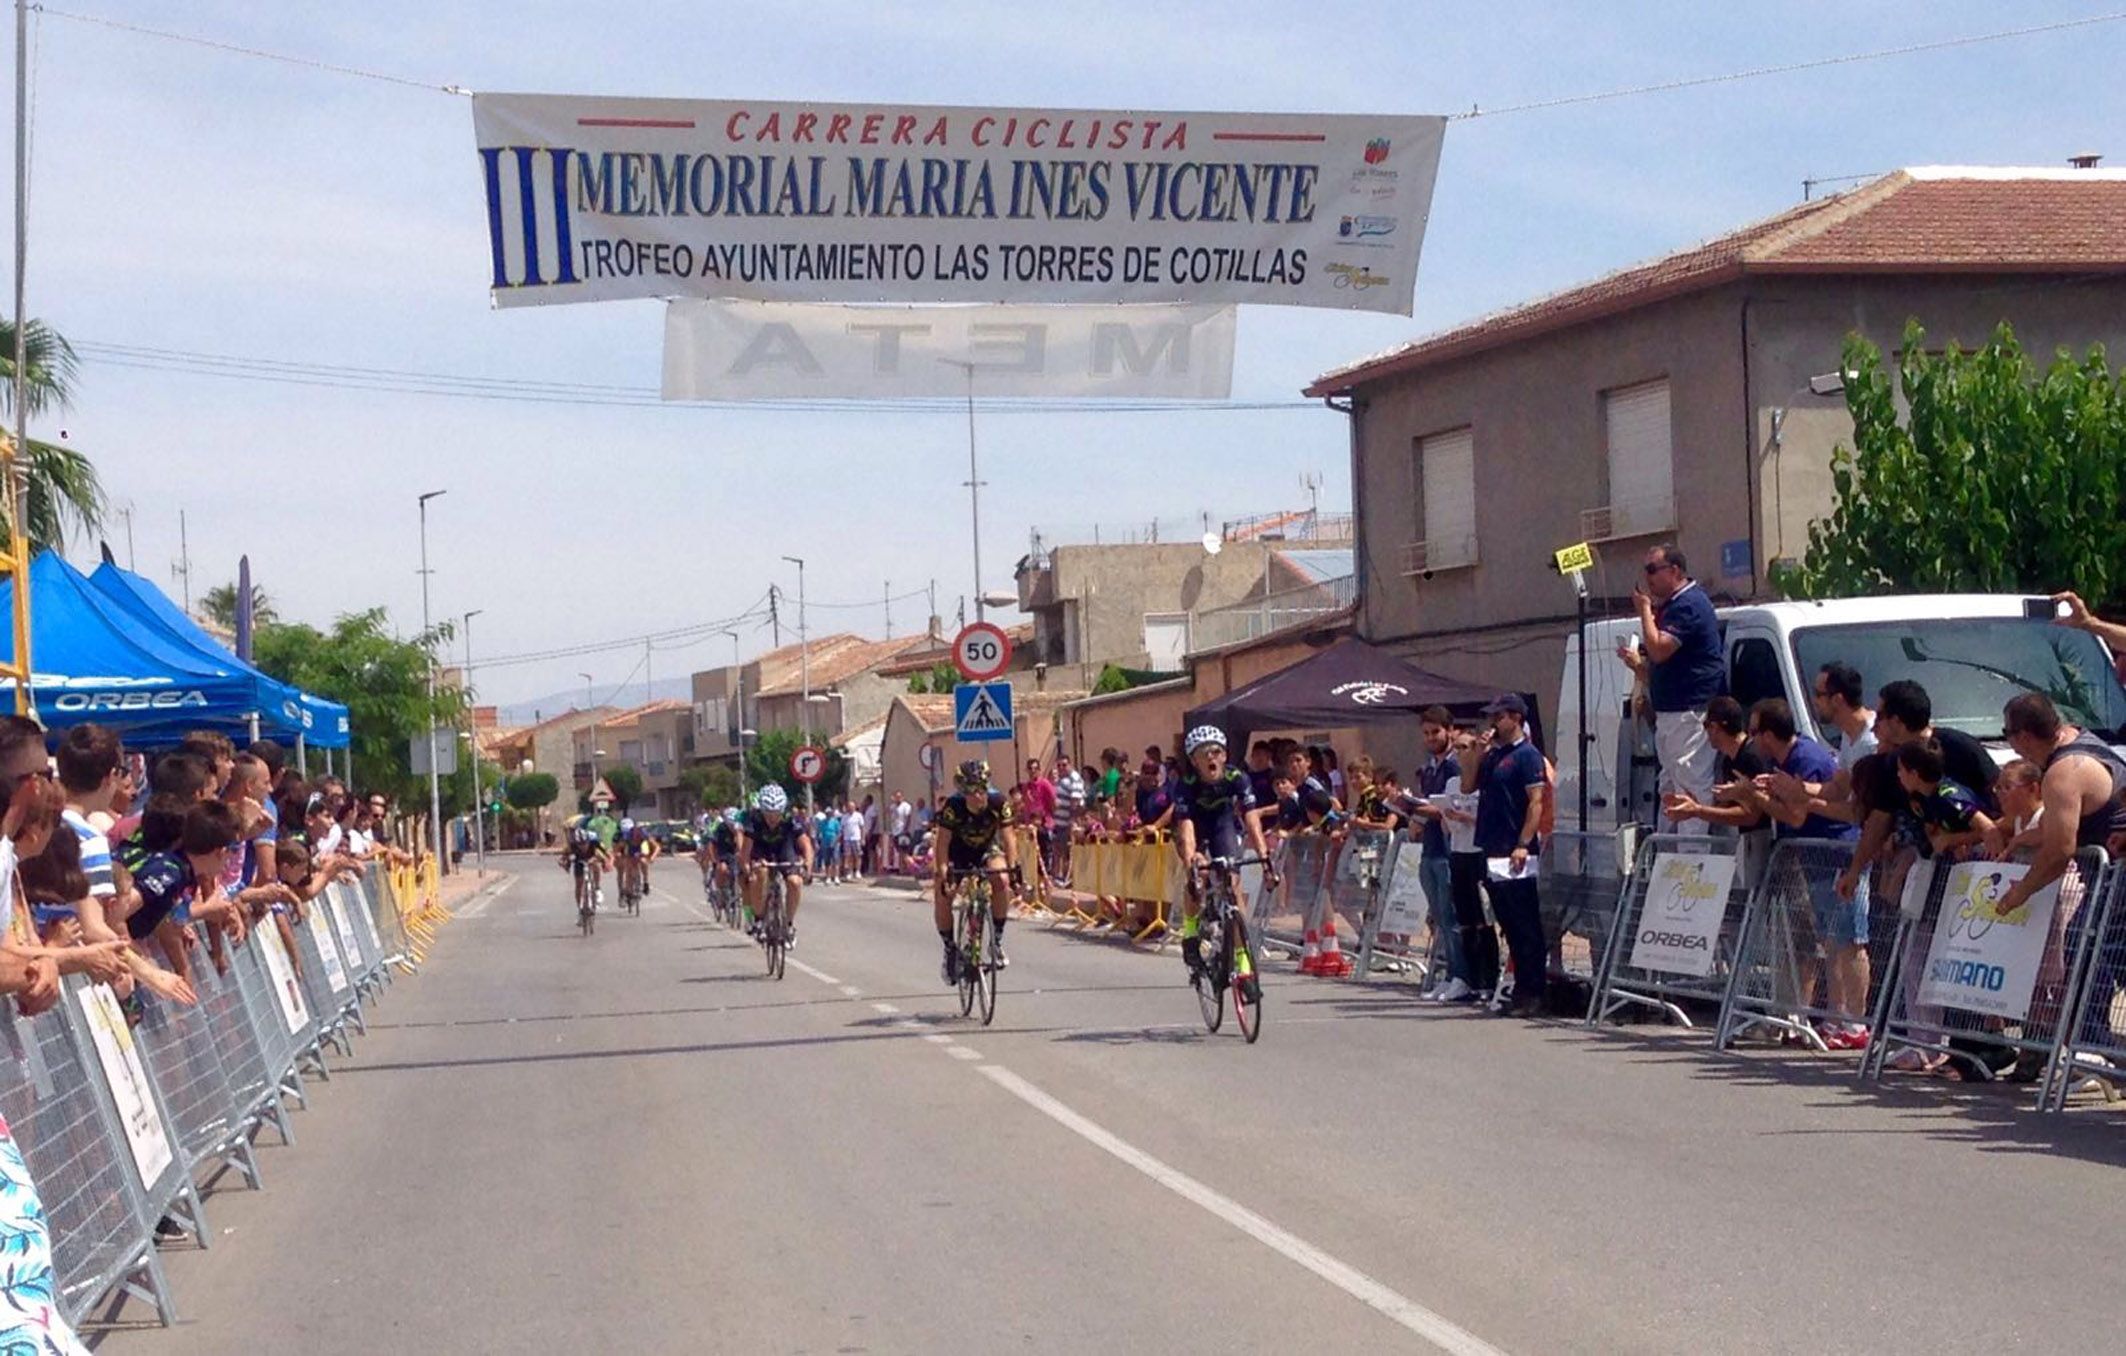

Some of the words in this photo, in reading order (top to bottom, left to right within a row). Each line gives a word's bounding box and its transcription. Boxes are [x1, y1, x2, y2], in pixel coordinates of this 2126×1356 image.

[726, 110, 948, 144] CARRERA
[971, 116, 1187, 150] CICLISTA
[479, 146, 582, 288] III
[577, 152, 836, 218] MEMORIAL
[844, 156, 998, 220] MARIA
[1006, 159, 1111, 222] INES
[1122, 162, 1319, 225] VICENTE
[580, 239, 694, 280] TROFEO
[702, 244, 925, 281] AYUNTAMIENTO
[934, 244, 989, 281] LAS
[1000, 245, 1113, 283] TORRES
[1123, 246, 1159, 283] DE
[1169, 247, 1307, 286] COTILLAS
[966, 642, 998, 661] 50
[55, 690, 208, 710] ORBEA
[1641, 930, 1708, 951] ORBEA
